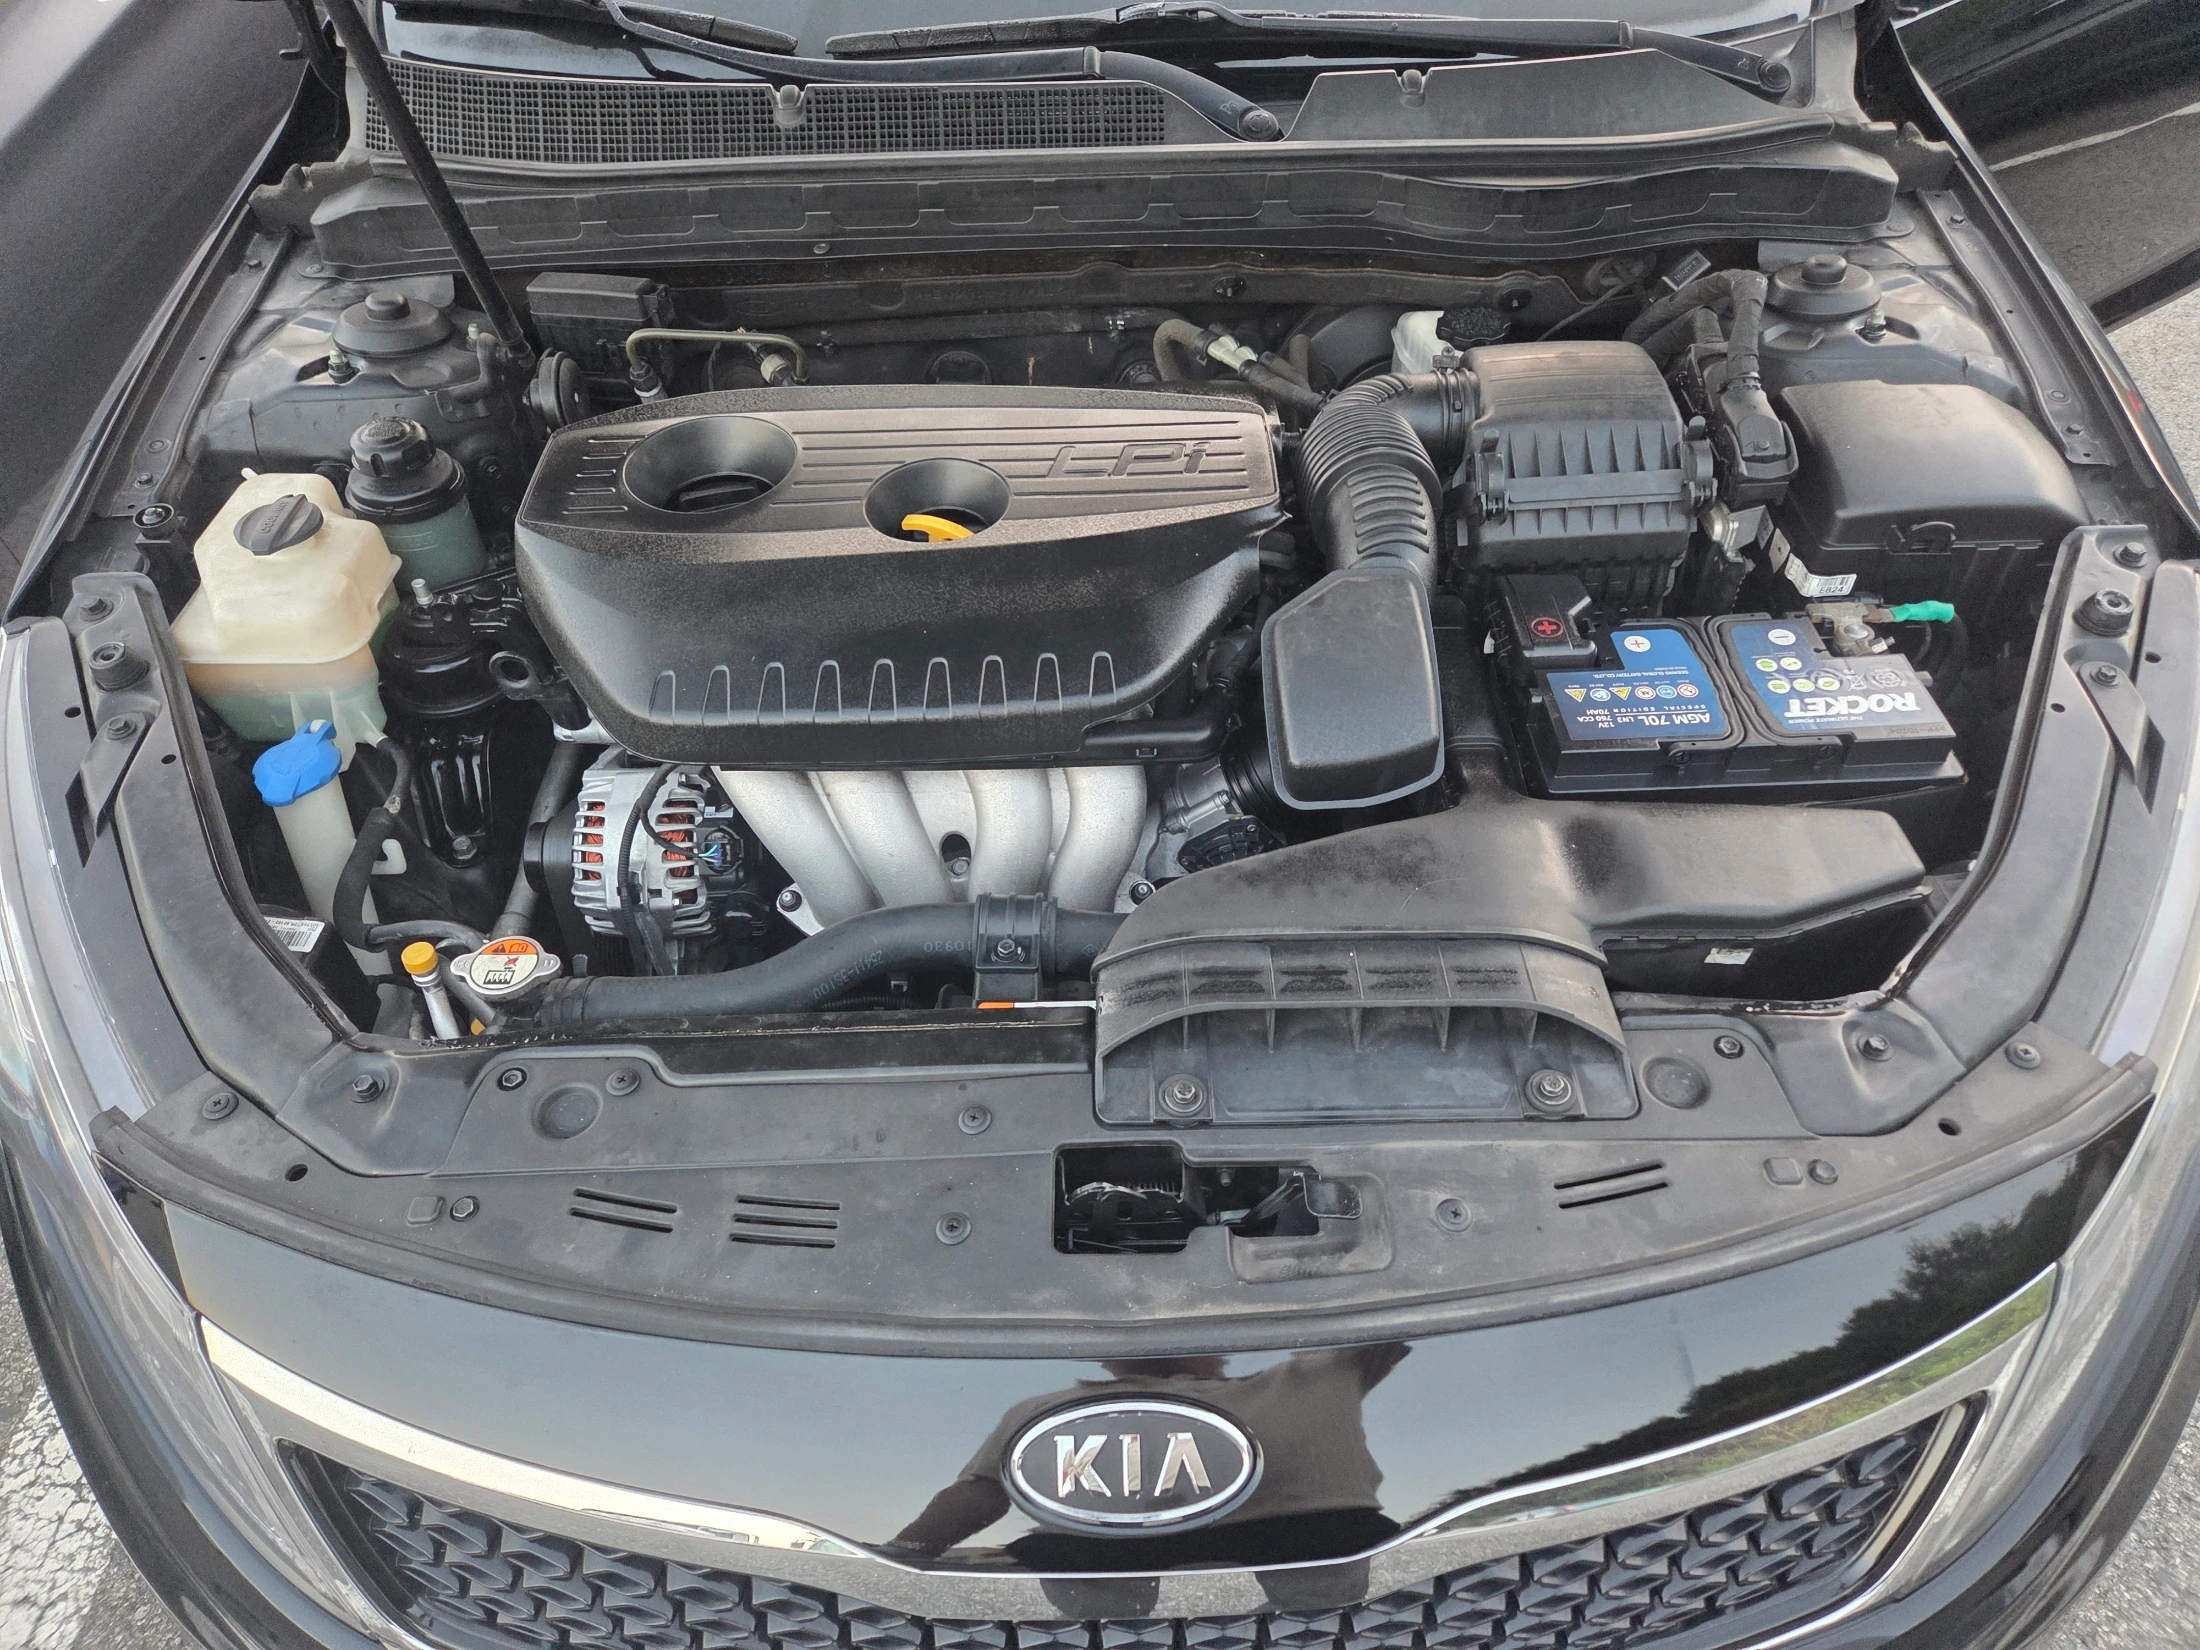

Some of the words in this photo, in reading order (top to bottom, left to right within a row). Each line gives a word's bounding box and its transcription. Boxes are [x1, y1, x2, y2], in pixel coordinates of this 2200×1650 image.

[1820, 586, 1844, 594] E824
[1784, 692, 1921, 718] ROCKET
[1617, 716, 1635, 724] LN3
[1637, 714, 1671, 726] 70L
[1674, 712, 1710, 725] AGM
[1053, 1432, 1213, 1498] KIA
